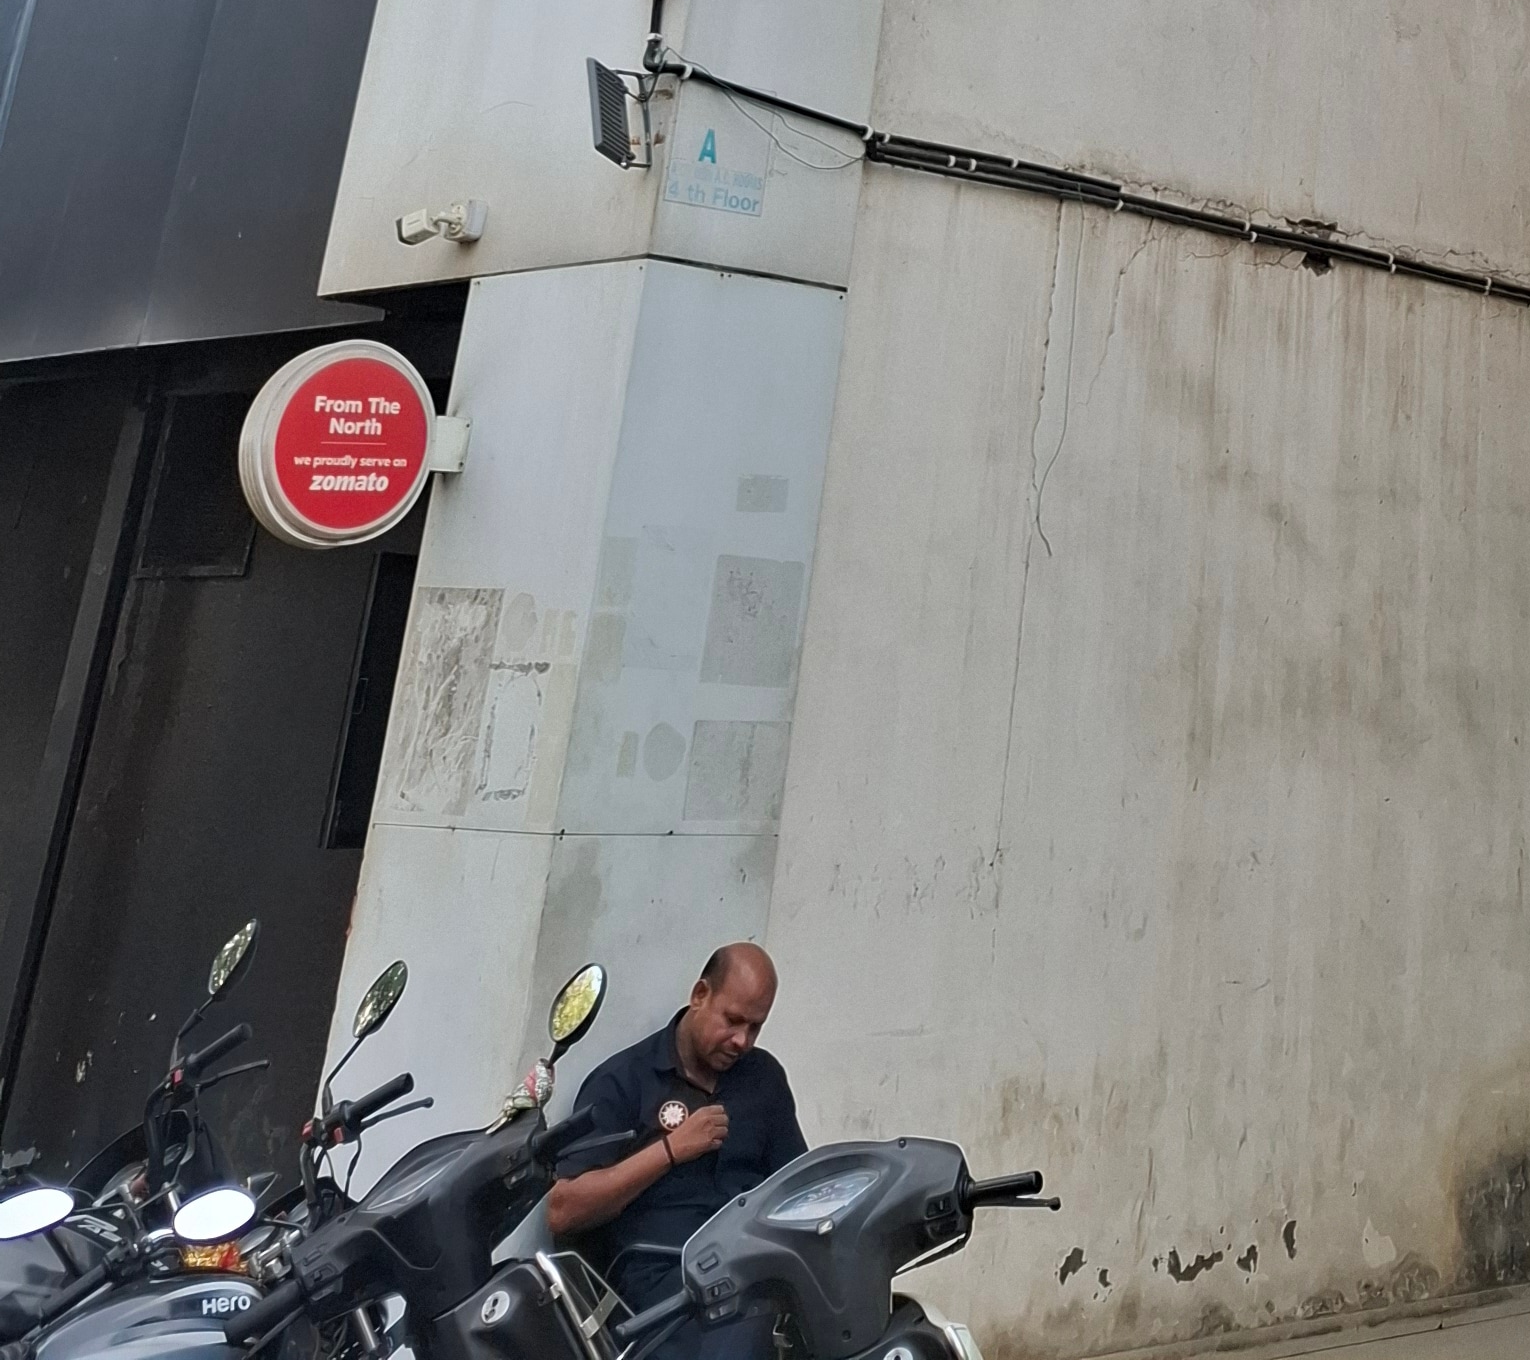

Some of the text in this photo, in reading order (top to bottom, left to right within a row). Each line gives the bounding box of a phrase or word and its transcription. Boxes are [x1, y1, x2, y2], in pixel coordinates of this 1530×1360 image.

[698, 128, 717, 164] A
[712, 187, 760, 213] Floor
[314, 395, 402, 415] From The
[329, 417, 383, 436] North
[293, 456, 311, 466] we
[312, 454, 358, 470] proudly
[359, 457, 391, 467] serve
[308, 472, 389, 492] zomato
[202, 1295, 251, 1315] Hero
